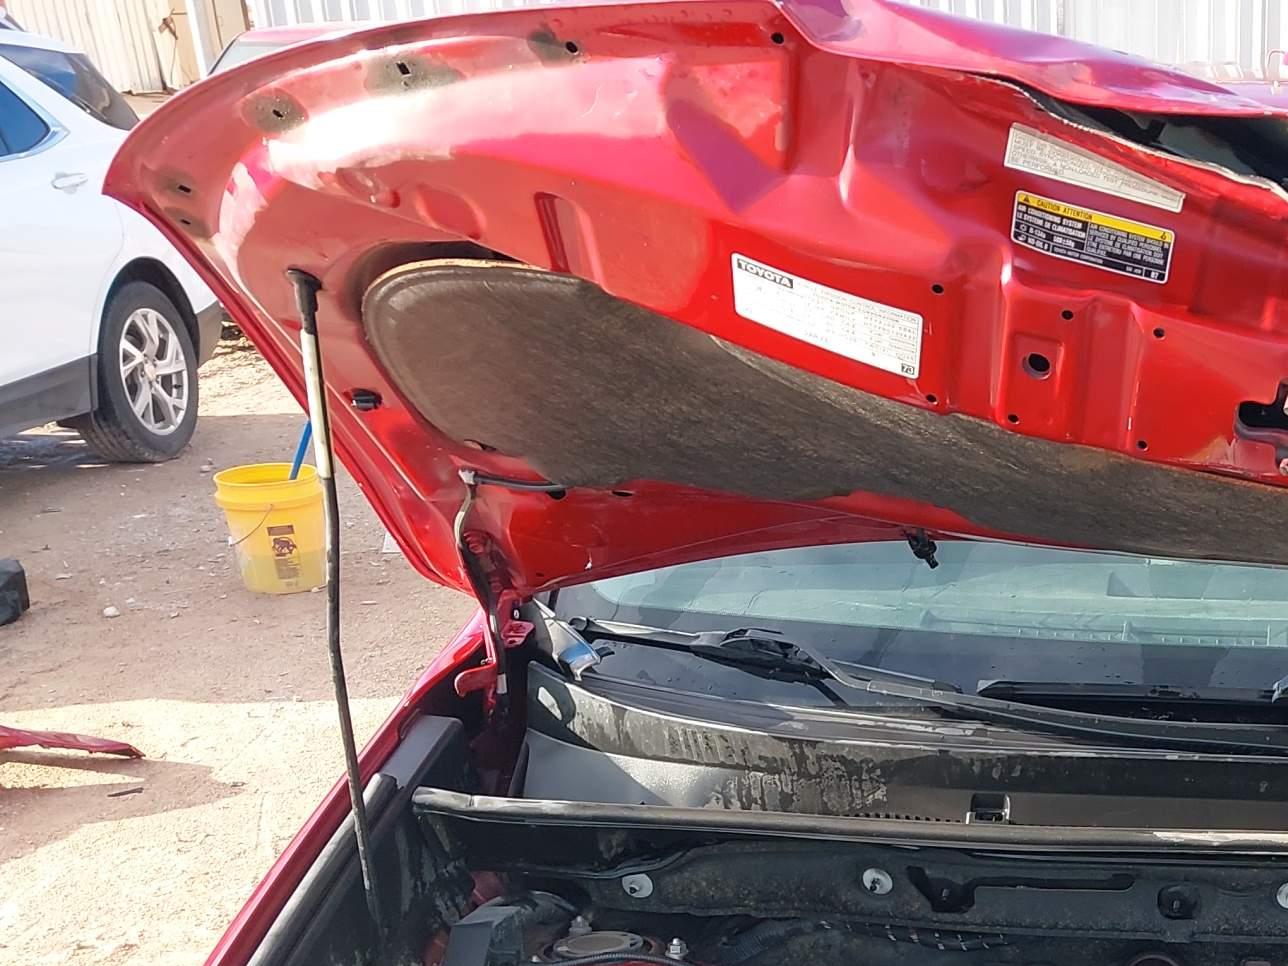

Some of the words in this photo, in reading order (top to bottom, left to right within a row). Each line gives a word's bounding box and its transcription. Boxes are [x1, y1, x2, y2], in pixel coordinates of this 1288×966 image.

[1037, 199, 1060, 212] CAUTION
[1063, 207, 1092, 220] ATTENTION
[738, 260, 792, 288] TOYOTA
